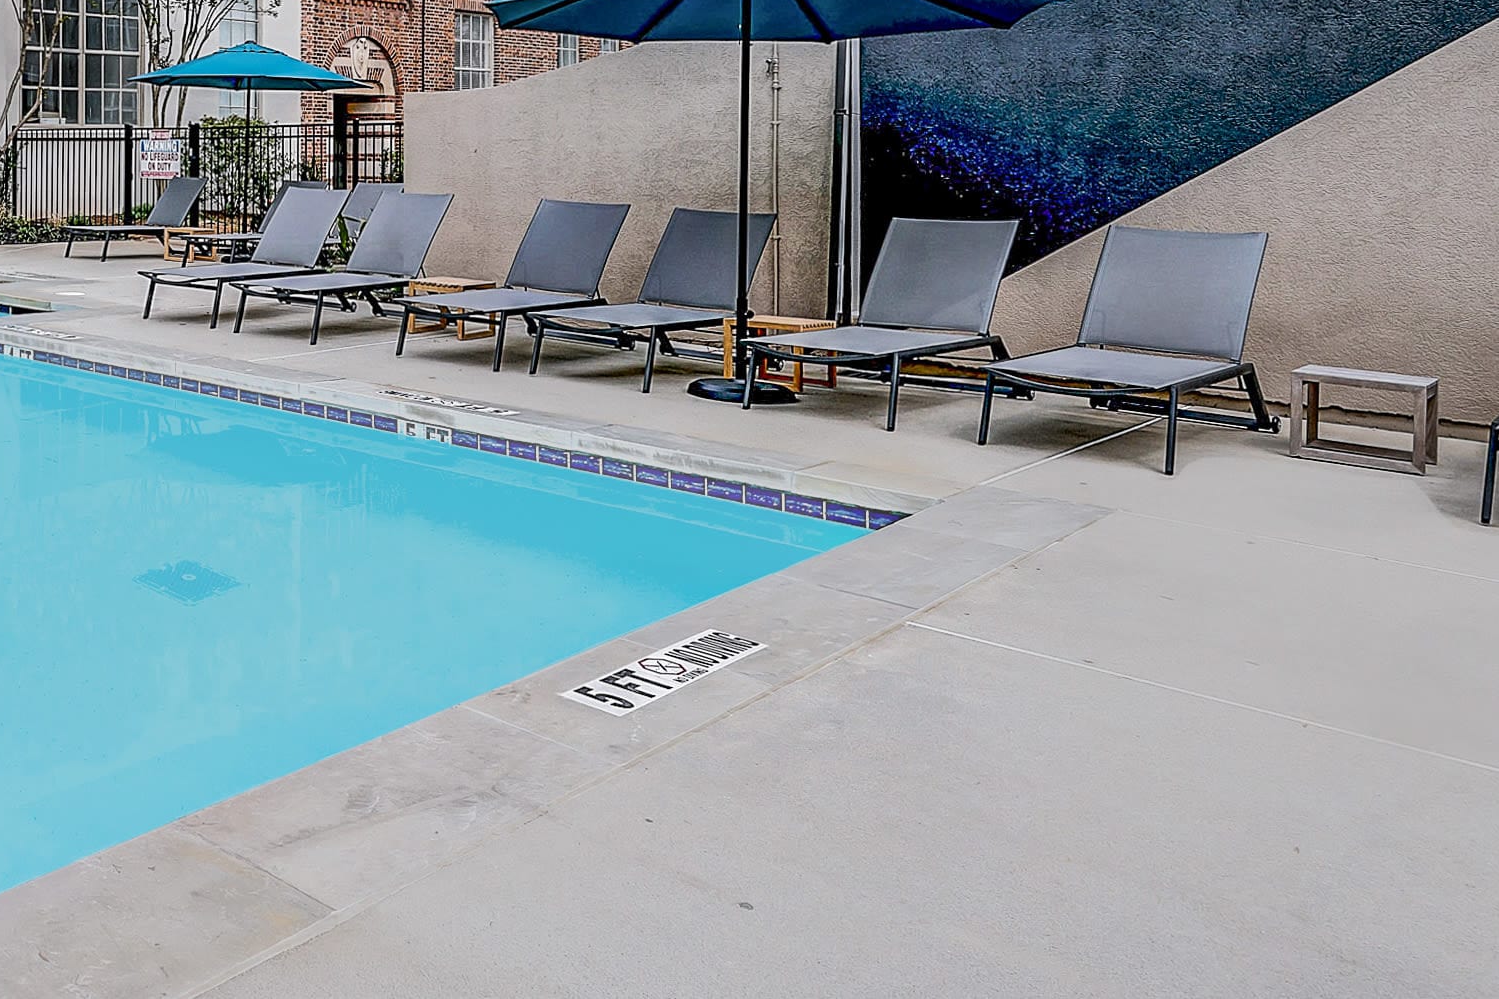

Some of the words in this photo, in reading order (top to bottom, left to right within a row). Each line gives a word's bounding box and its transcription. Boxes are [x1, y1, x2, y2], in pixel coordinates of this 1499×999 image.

[144, 140, 177, 152] WARNING
[141, 152, 148, 161] NO
[150, 152, 179, 161] LIFEGUARD
[148, 162, 156, 171] ON
[157, 162, 171, 171] DUTY
[425, 425, 449, 443] FT
[682, 631, 760, 660] DIVING
[663, 648, 720, 668] NO
[599, 668, 674, 699] FT
[573, 686, 635, 709] 5
